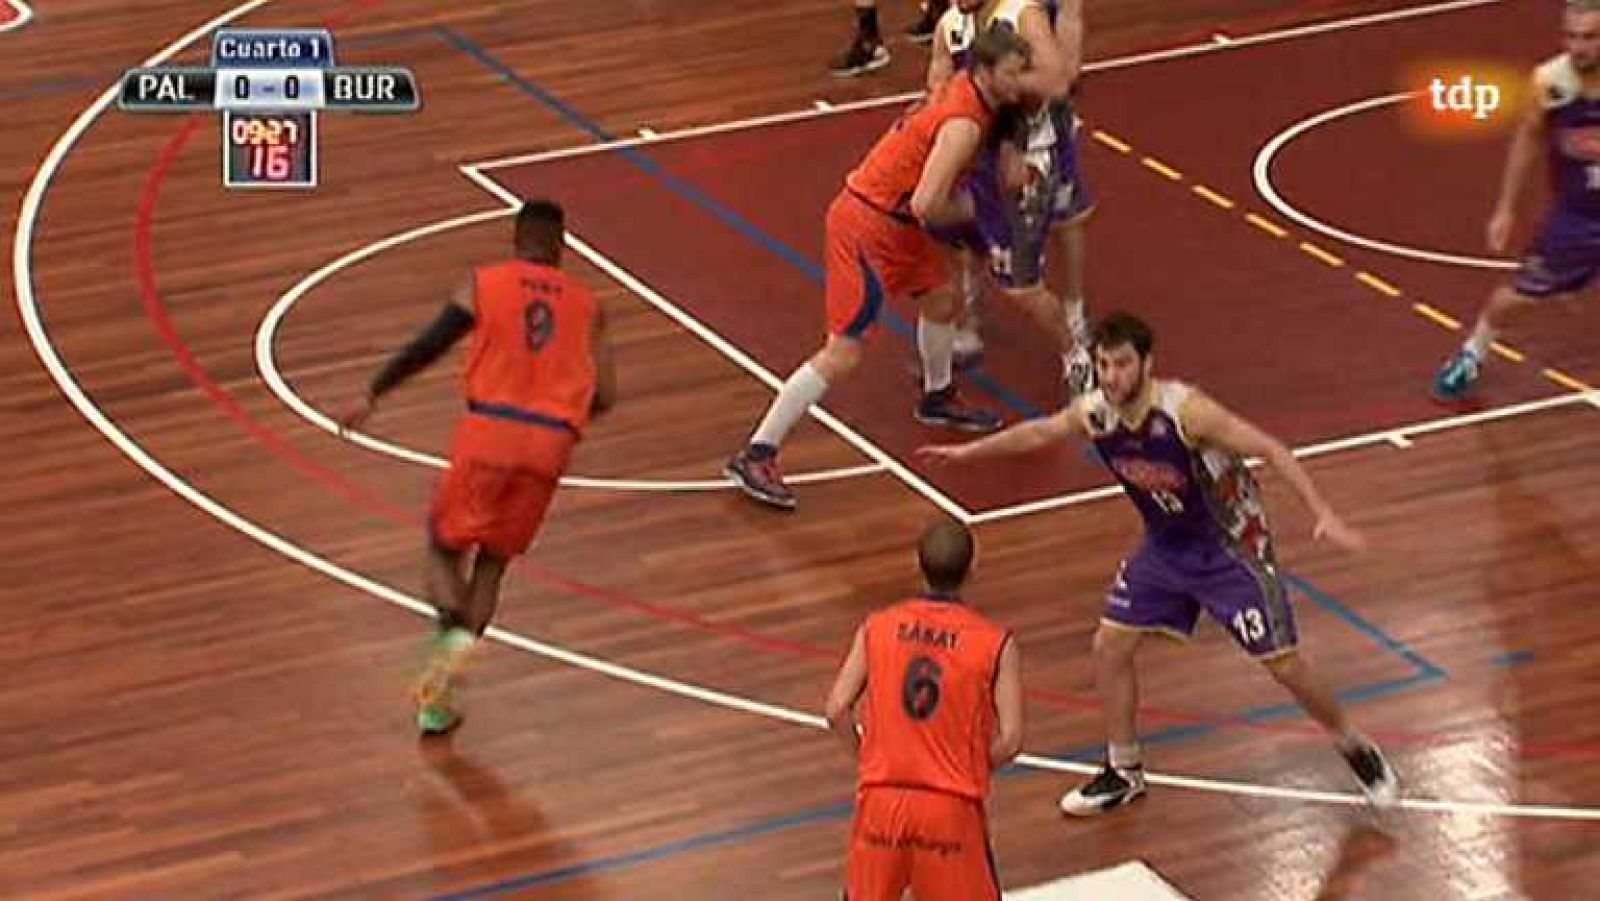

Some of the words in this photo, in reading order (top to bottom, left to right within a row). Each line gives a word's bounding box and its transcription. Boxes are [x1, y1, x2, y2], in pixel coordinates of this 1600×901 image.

[525, 298, 554, 354] 9
[1231, 606, 1267, 644] 13
[903, 656, 941, 721] 6
